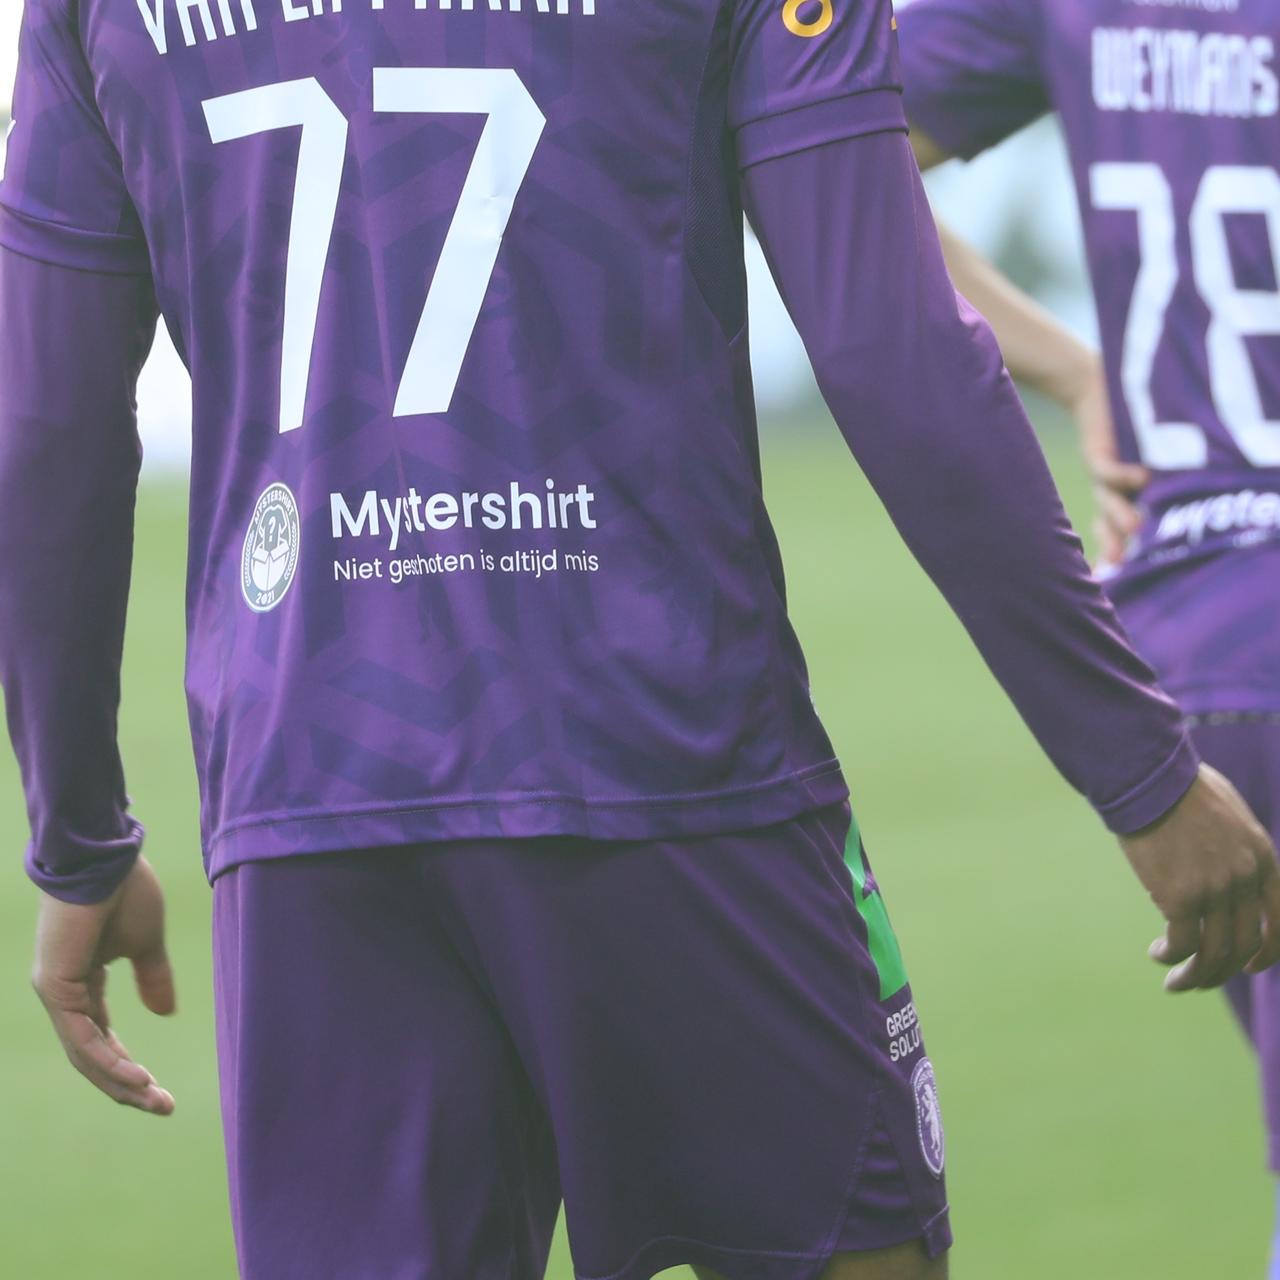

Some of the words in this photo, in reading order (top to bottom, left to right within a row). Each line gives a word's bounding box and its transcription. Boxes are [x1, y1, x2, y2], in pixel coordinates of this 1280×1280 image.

[201, 67, 547, 434] 77
[330, 478, 597, 551] Mystershirt
[333, 559, 383, 582] Niet
[481, 548, 495, 571] is
[500, 548, 558, 579] altijd
[565, 550, 600, 572] mis
